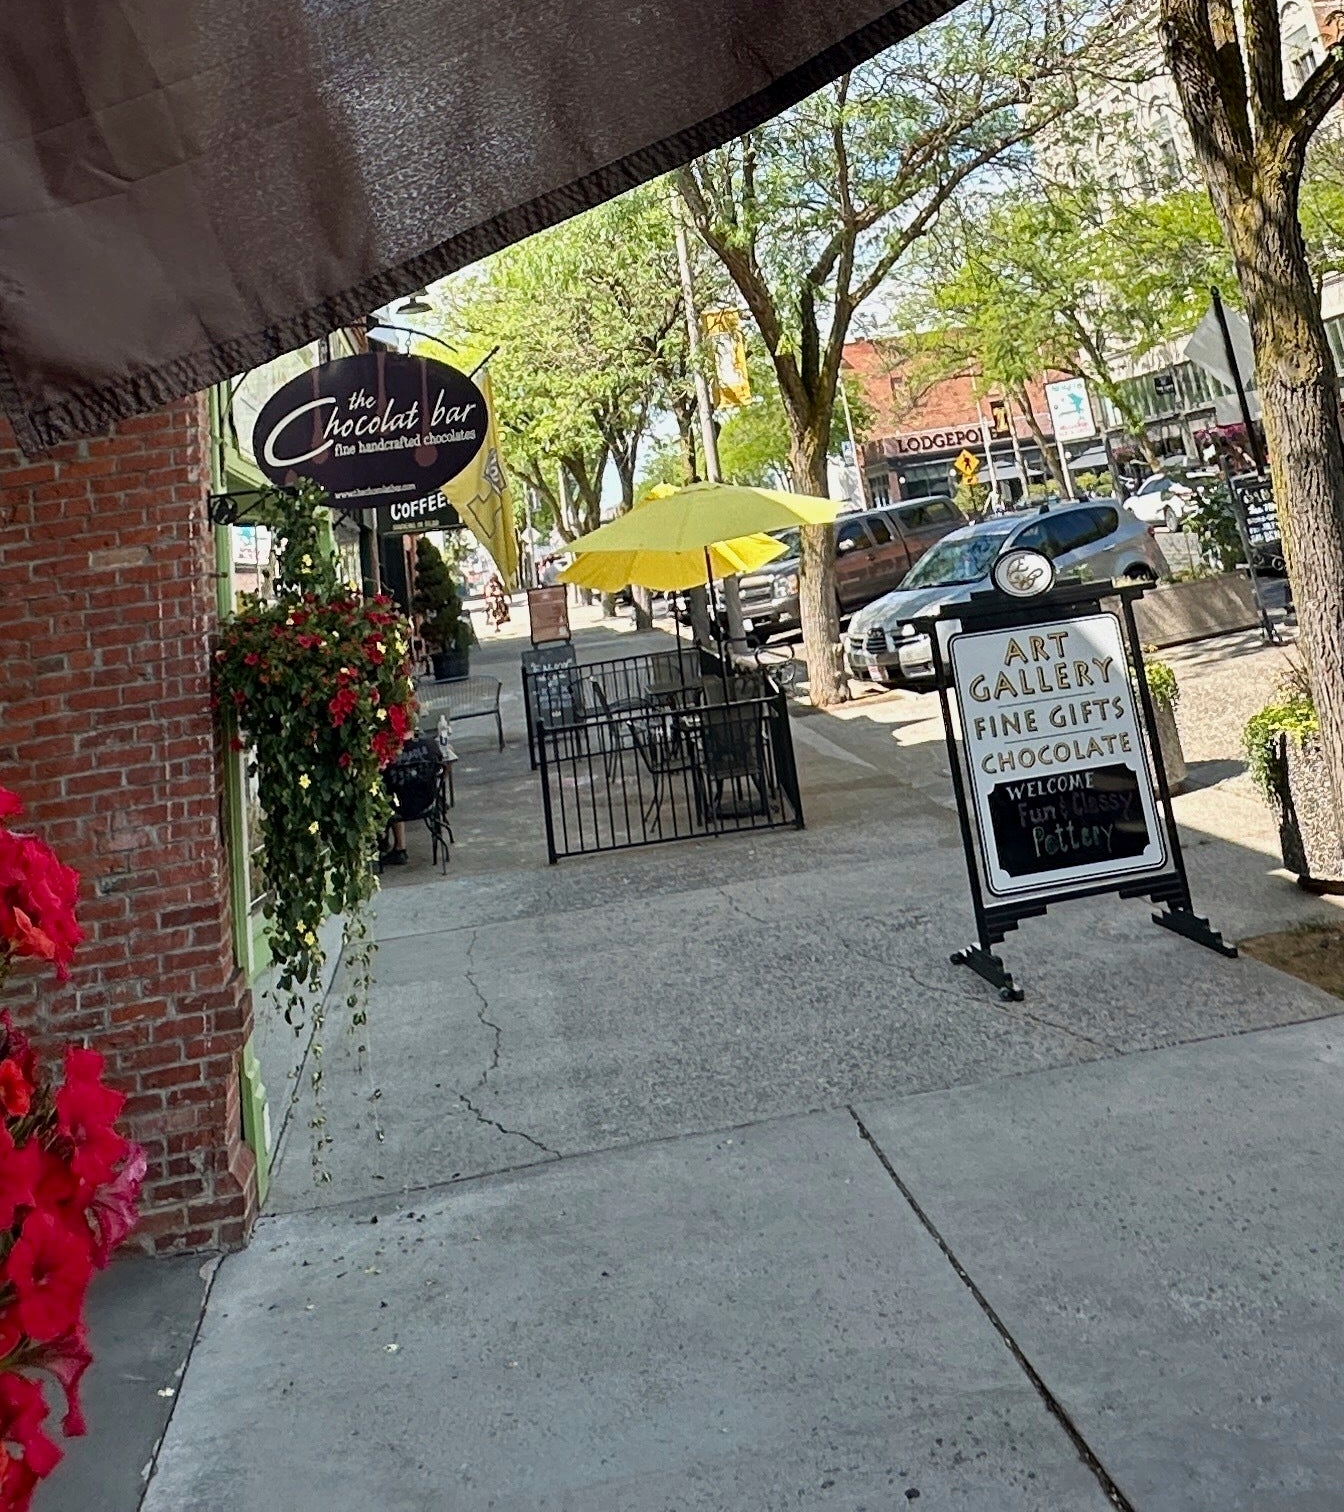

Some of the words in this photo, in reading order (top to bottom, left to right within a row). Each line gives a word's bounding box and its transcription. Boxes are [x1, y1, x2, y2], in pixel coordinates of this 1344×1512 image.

[348, 388, 377, 411] the
[263, 396, 420, 468] Chocolat
[430, 388, 477, 428] bar
[334, 443, 356, 457] fine
[358, 434, 421, 454] handcrafted
[422, 429, 477, 446] chocolates
[390, 491, 452, 521] COFFEE
[1004, 631, 1069, 666] ART
[969, 656, 1114, 703] GALLERY
[974, 709, 1038, 740] FINE
[1049, 696, 1125, 728] GIFTS
[981, 731, 1132, 774] CHOCOLATE
[1006, 771, 1095, 801] WELCOME
